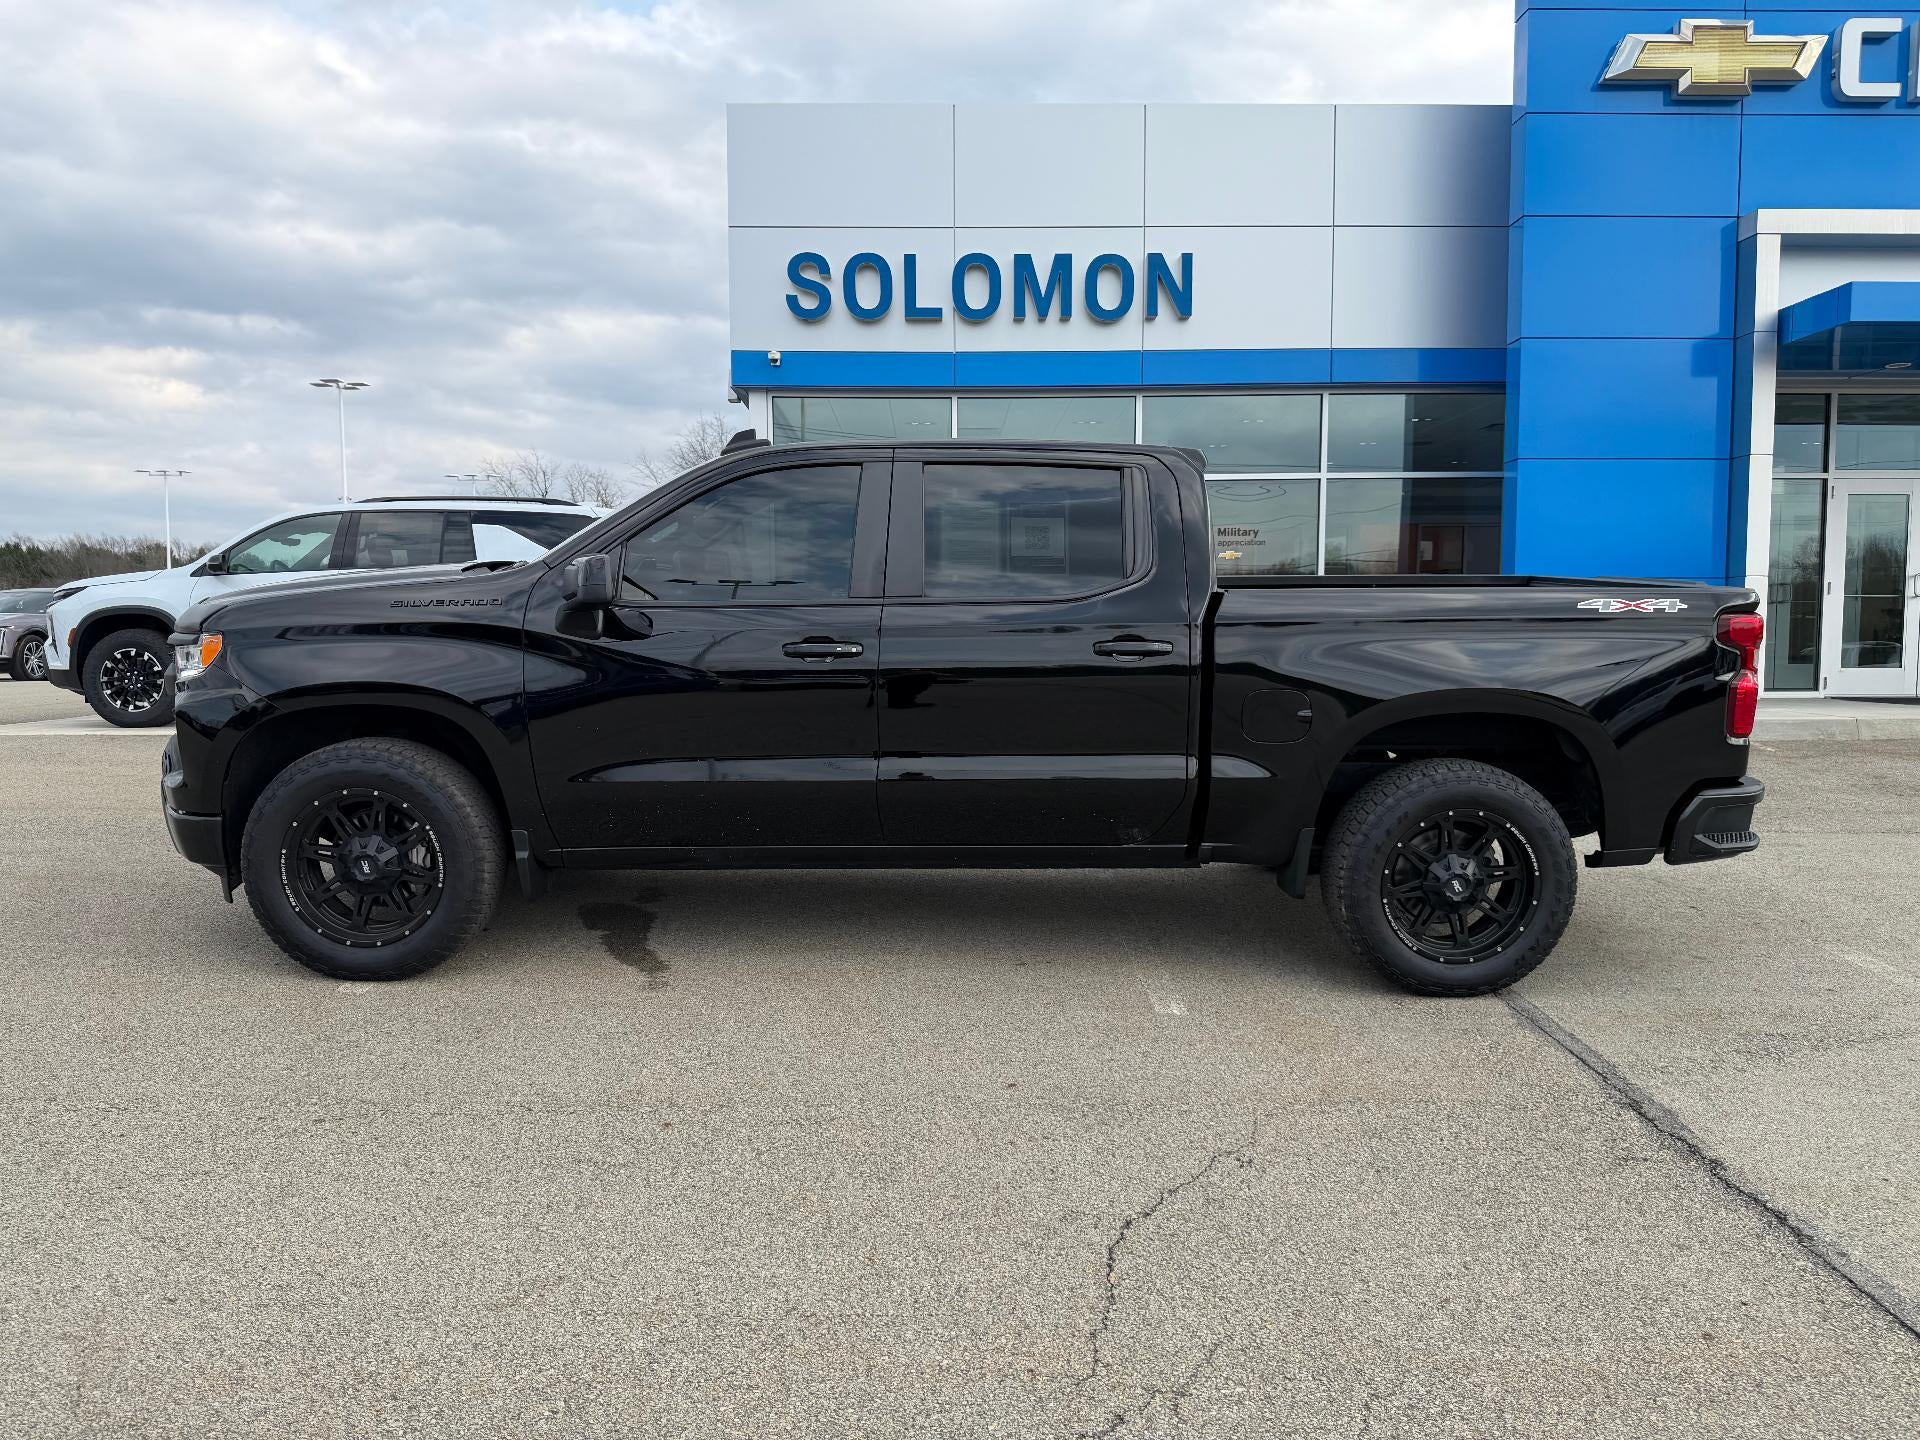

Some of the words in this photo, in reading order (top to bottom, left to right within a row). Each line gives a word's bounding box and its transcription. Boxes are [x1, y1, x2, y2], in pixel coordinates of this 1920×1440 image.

[1832, 17, 1920, 103] C
[786, 252, 1193, 322] SOLOMON
[1217, 527, 1259, 538] Military
[1217, 539, 1267, 547] appreciation
[390, 598, 503, 608] SILVERADO
[280, 854, 288, 884] COUNTRY
[360, 860, 371, 874] RC
[428, 830, 440, 852] ROUGH
[436, 852, 444, 883] COUNTRY
[1524, 843, 1539, 871] COUNTRY
